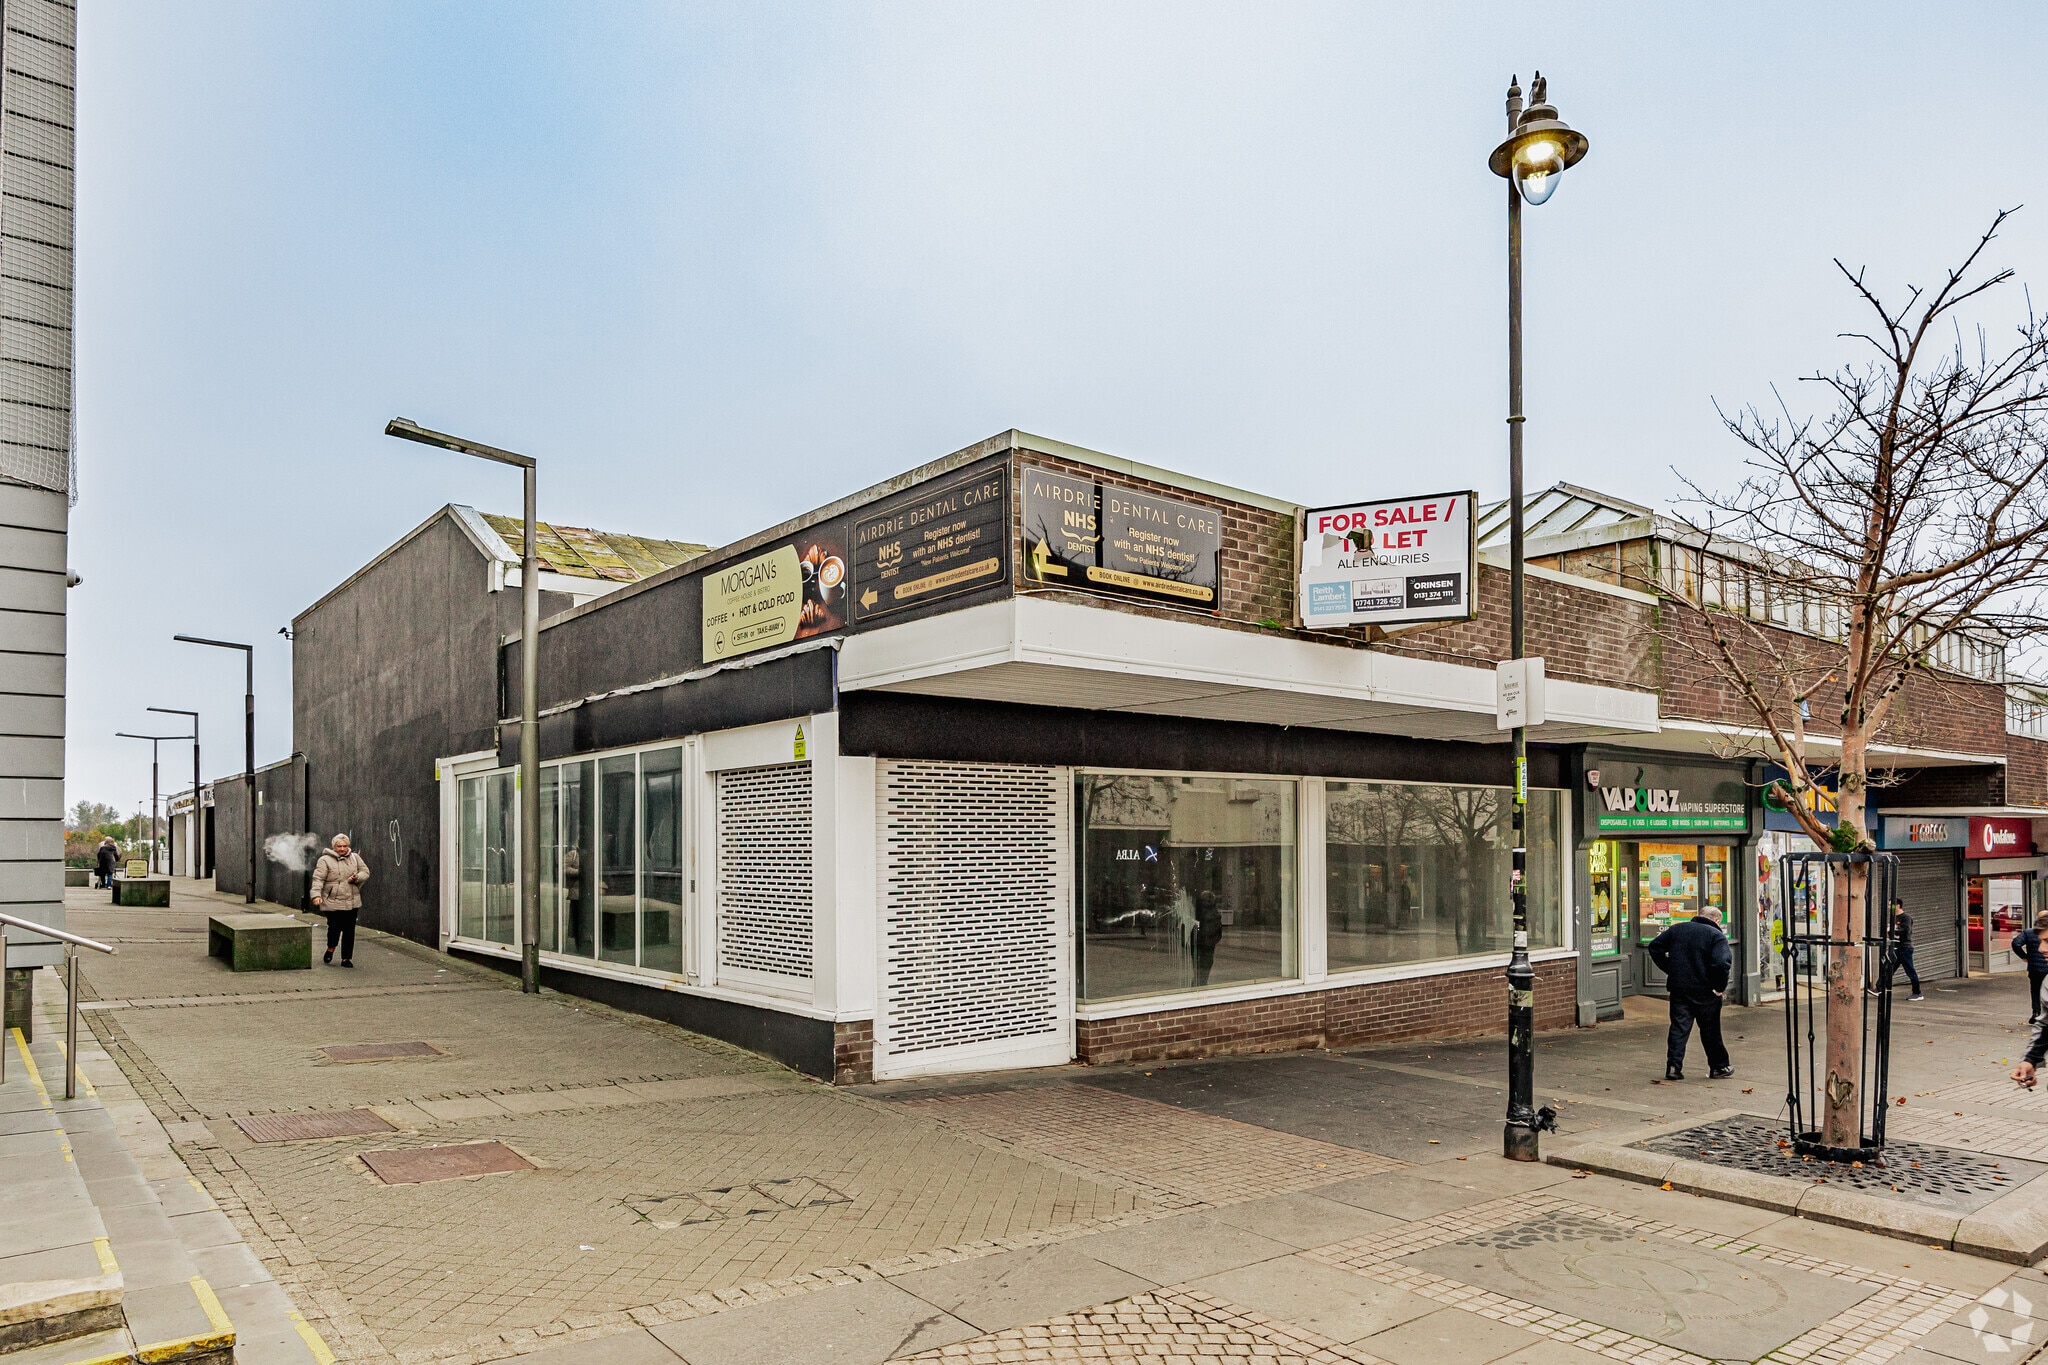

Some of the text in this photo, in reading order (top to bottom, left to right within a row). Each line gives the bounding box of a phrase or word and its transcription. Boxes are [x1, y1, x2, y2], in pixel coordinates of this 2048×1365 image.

[859, 481, 999, 543] AIRDRIE DENTAL CARE
[1033, 482, 1214, 535] AIRDRIE DENTAL CARE
[1319, 512, 1367, 534] FOR
[1374, 503, 1437, 527] SALE
[924, 520, 967, 541] Register now
[1064, 510, 1097, 531] NHS
[912, 529, 981, 559] with an NHS dentist!
[1128, 527, 1180, 546] Register now
[1383, 529, 1428, 549] LET
[878, 541, 901, 562] NHS
[1067, 542, 1095, 554] DENTIST
[1113, 539, 1195, 563] with an NHS dentist!
[1337, 552, 1430, 569] ALL ENQUIRIES
[720, 559, 777, 595] MORGAN's
[881, 567, 900, 579] DENTIST
[1099, 571, 1113, 582] BOOK
[1113, 573, 1131, 585] ONLINE
[1142, 579, 1204, 597] www.airdriedentalcare.co.uk
[1313, 586, 1334, 595] Reith
[1413, 580, 1454, 590] ORINSEN
[1313, 592, 1346, 602] Lambert
[706, 591, 795, 627] COFFEE HOT & COLD FOOD
[736, 631, 749, 641] SIT-IN
[756, 622, 780, 635] TAKE-AWAY
[1602, 787, 1745, 814] VAPOURZ VAPING SUPERSTORE
[1919, 824, 1948, 842] GREGGS
[1993, 829, 2016, 845] vodafone
